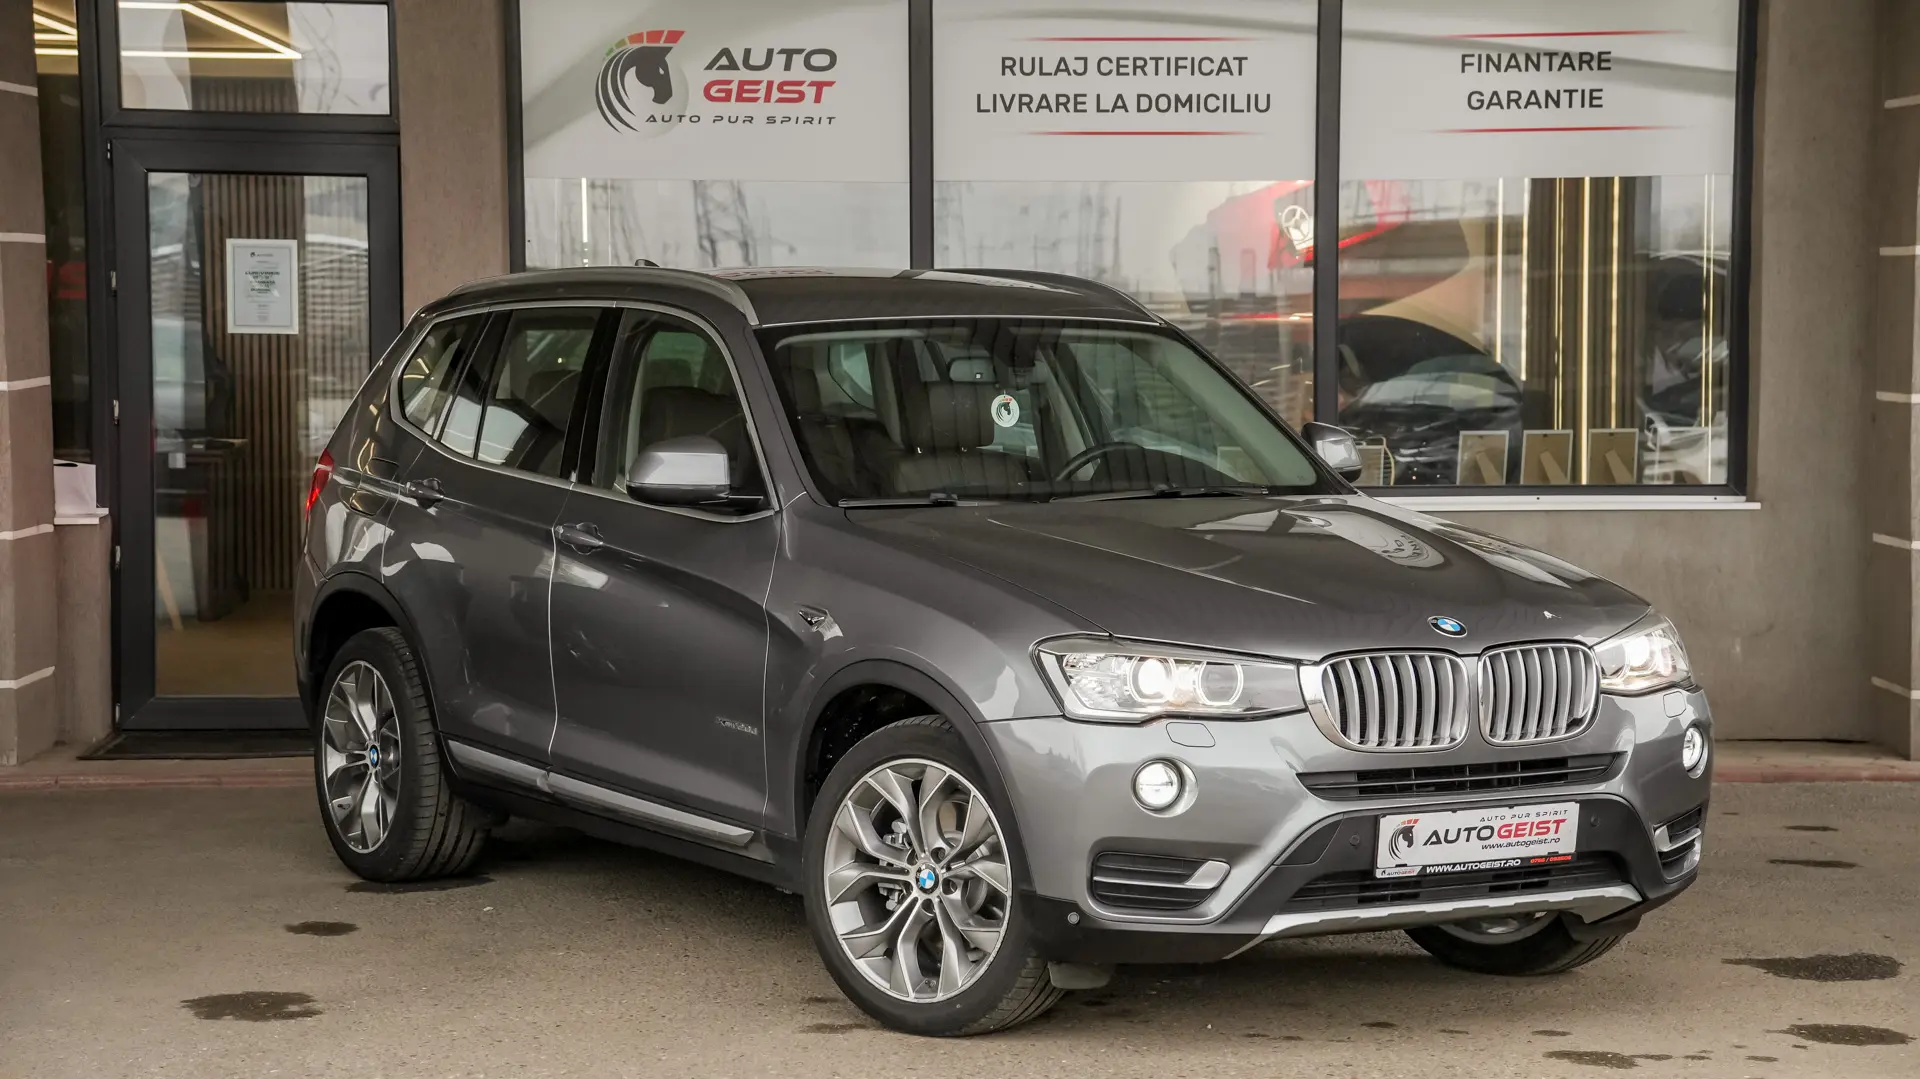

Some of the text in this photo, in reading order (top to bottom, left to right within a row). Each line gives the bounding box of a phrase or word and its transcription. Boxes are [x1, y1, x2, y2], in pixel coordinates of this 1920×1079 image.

[703, 47, 838, 72] AUTO
[1000, 56, 1248, 77] RULAJ CERTIFICAT
[1460, 51, 1612, 74] FINANTARE
[703, 79, 837, 104] GEIST
[1467, 88, 1604, 110] GARANTIE
[976, 93, 1272, 113] LIVRARE LA DOMICILIU
[645, 114, 837, 126] AUTO PUR SPIRIT
[1479, 814, 1506, 822] AUTO
[1535, 809, 1569, 818] SPIRIT
[1481, 837, 1561, 850] www.autogeist.ro
[1426, 858, 1521, 873] WWW.AUTOGEIST.RO
